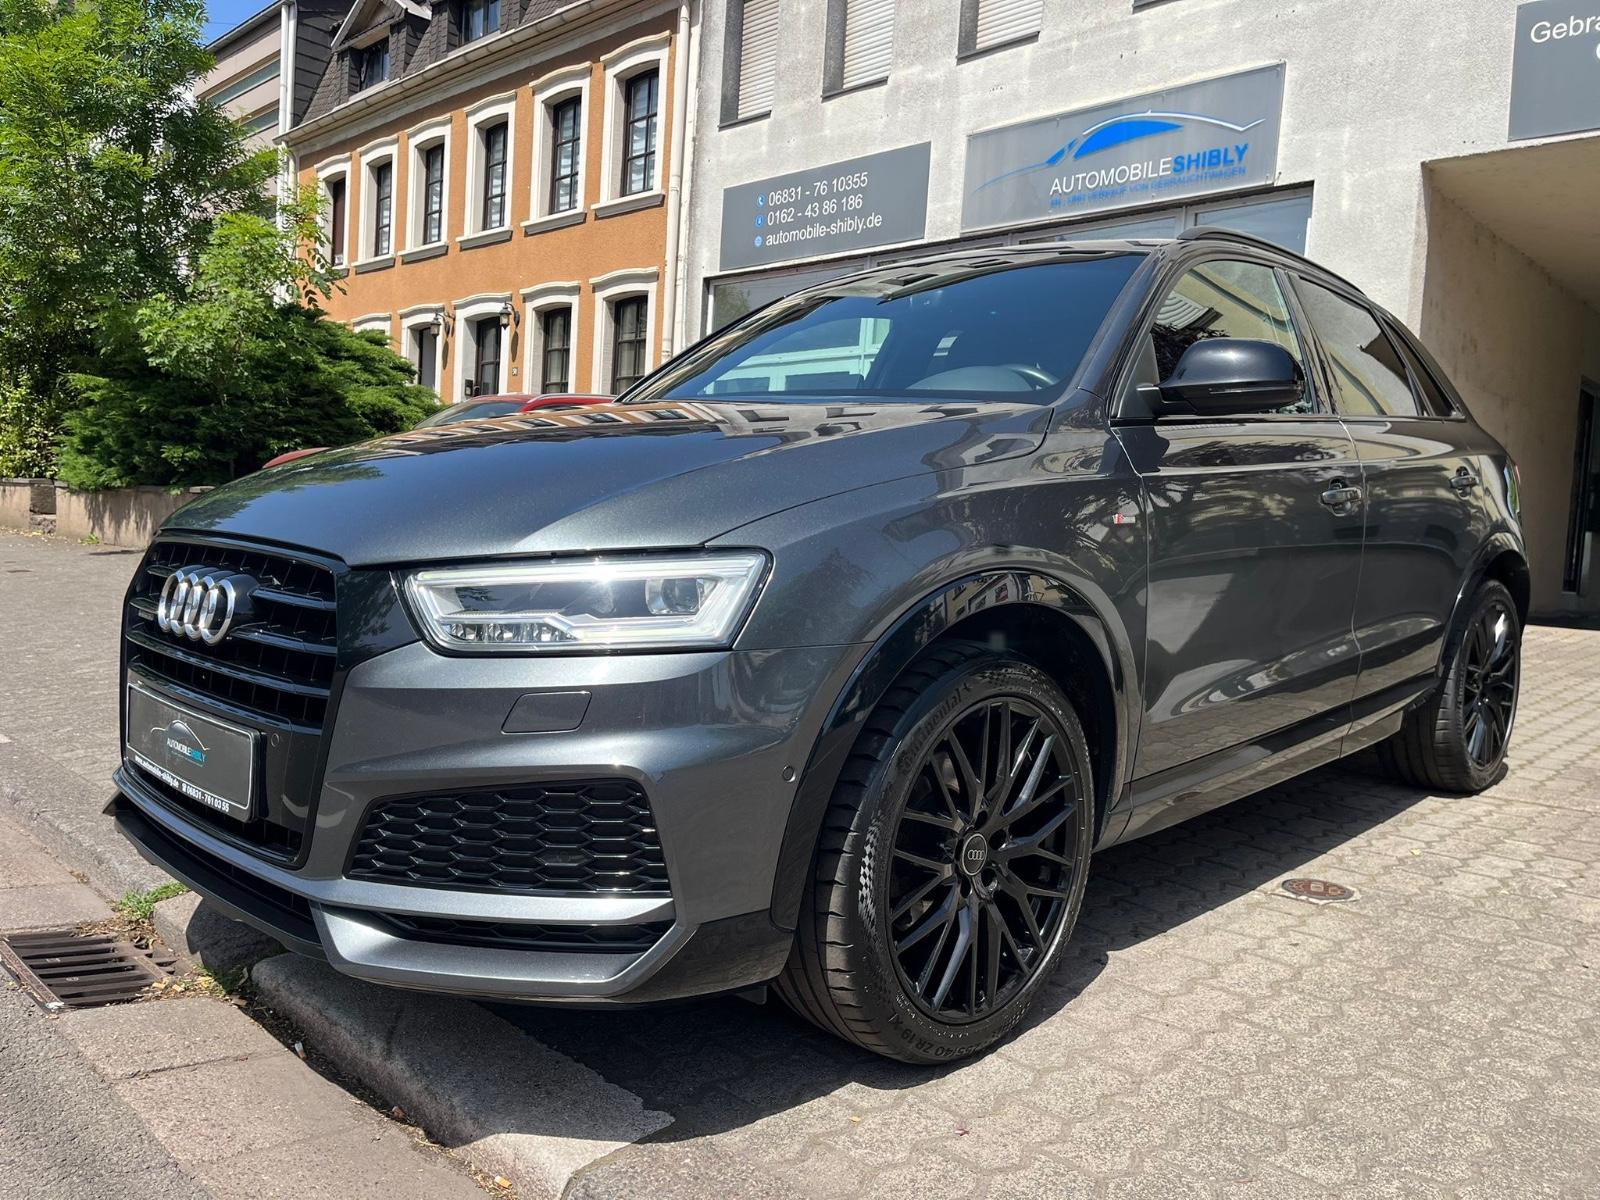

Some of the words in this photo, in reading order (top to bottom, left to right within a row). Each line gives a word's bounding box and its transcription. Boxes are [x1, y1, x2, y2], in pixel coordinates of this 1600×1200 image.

[768, 186, 801, 207] 06831
[813, 180, 828, 197] 76
[832, 172, 868, 194] 10355
[767, 208, 795, 226] 0162
[804, 202, 820, 219] 43
[822, 199, 837, 215] 86
[841, 194, 863, 212] 186
[766, 212, 882, 247] automobile-shibly.de
